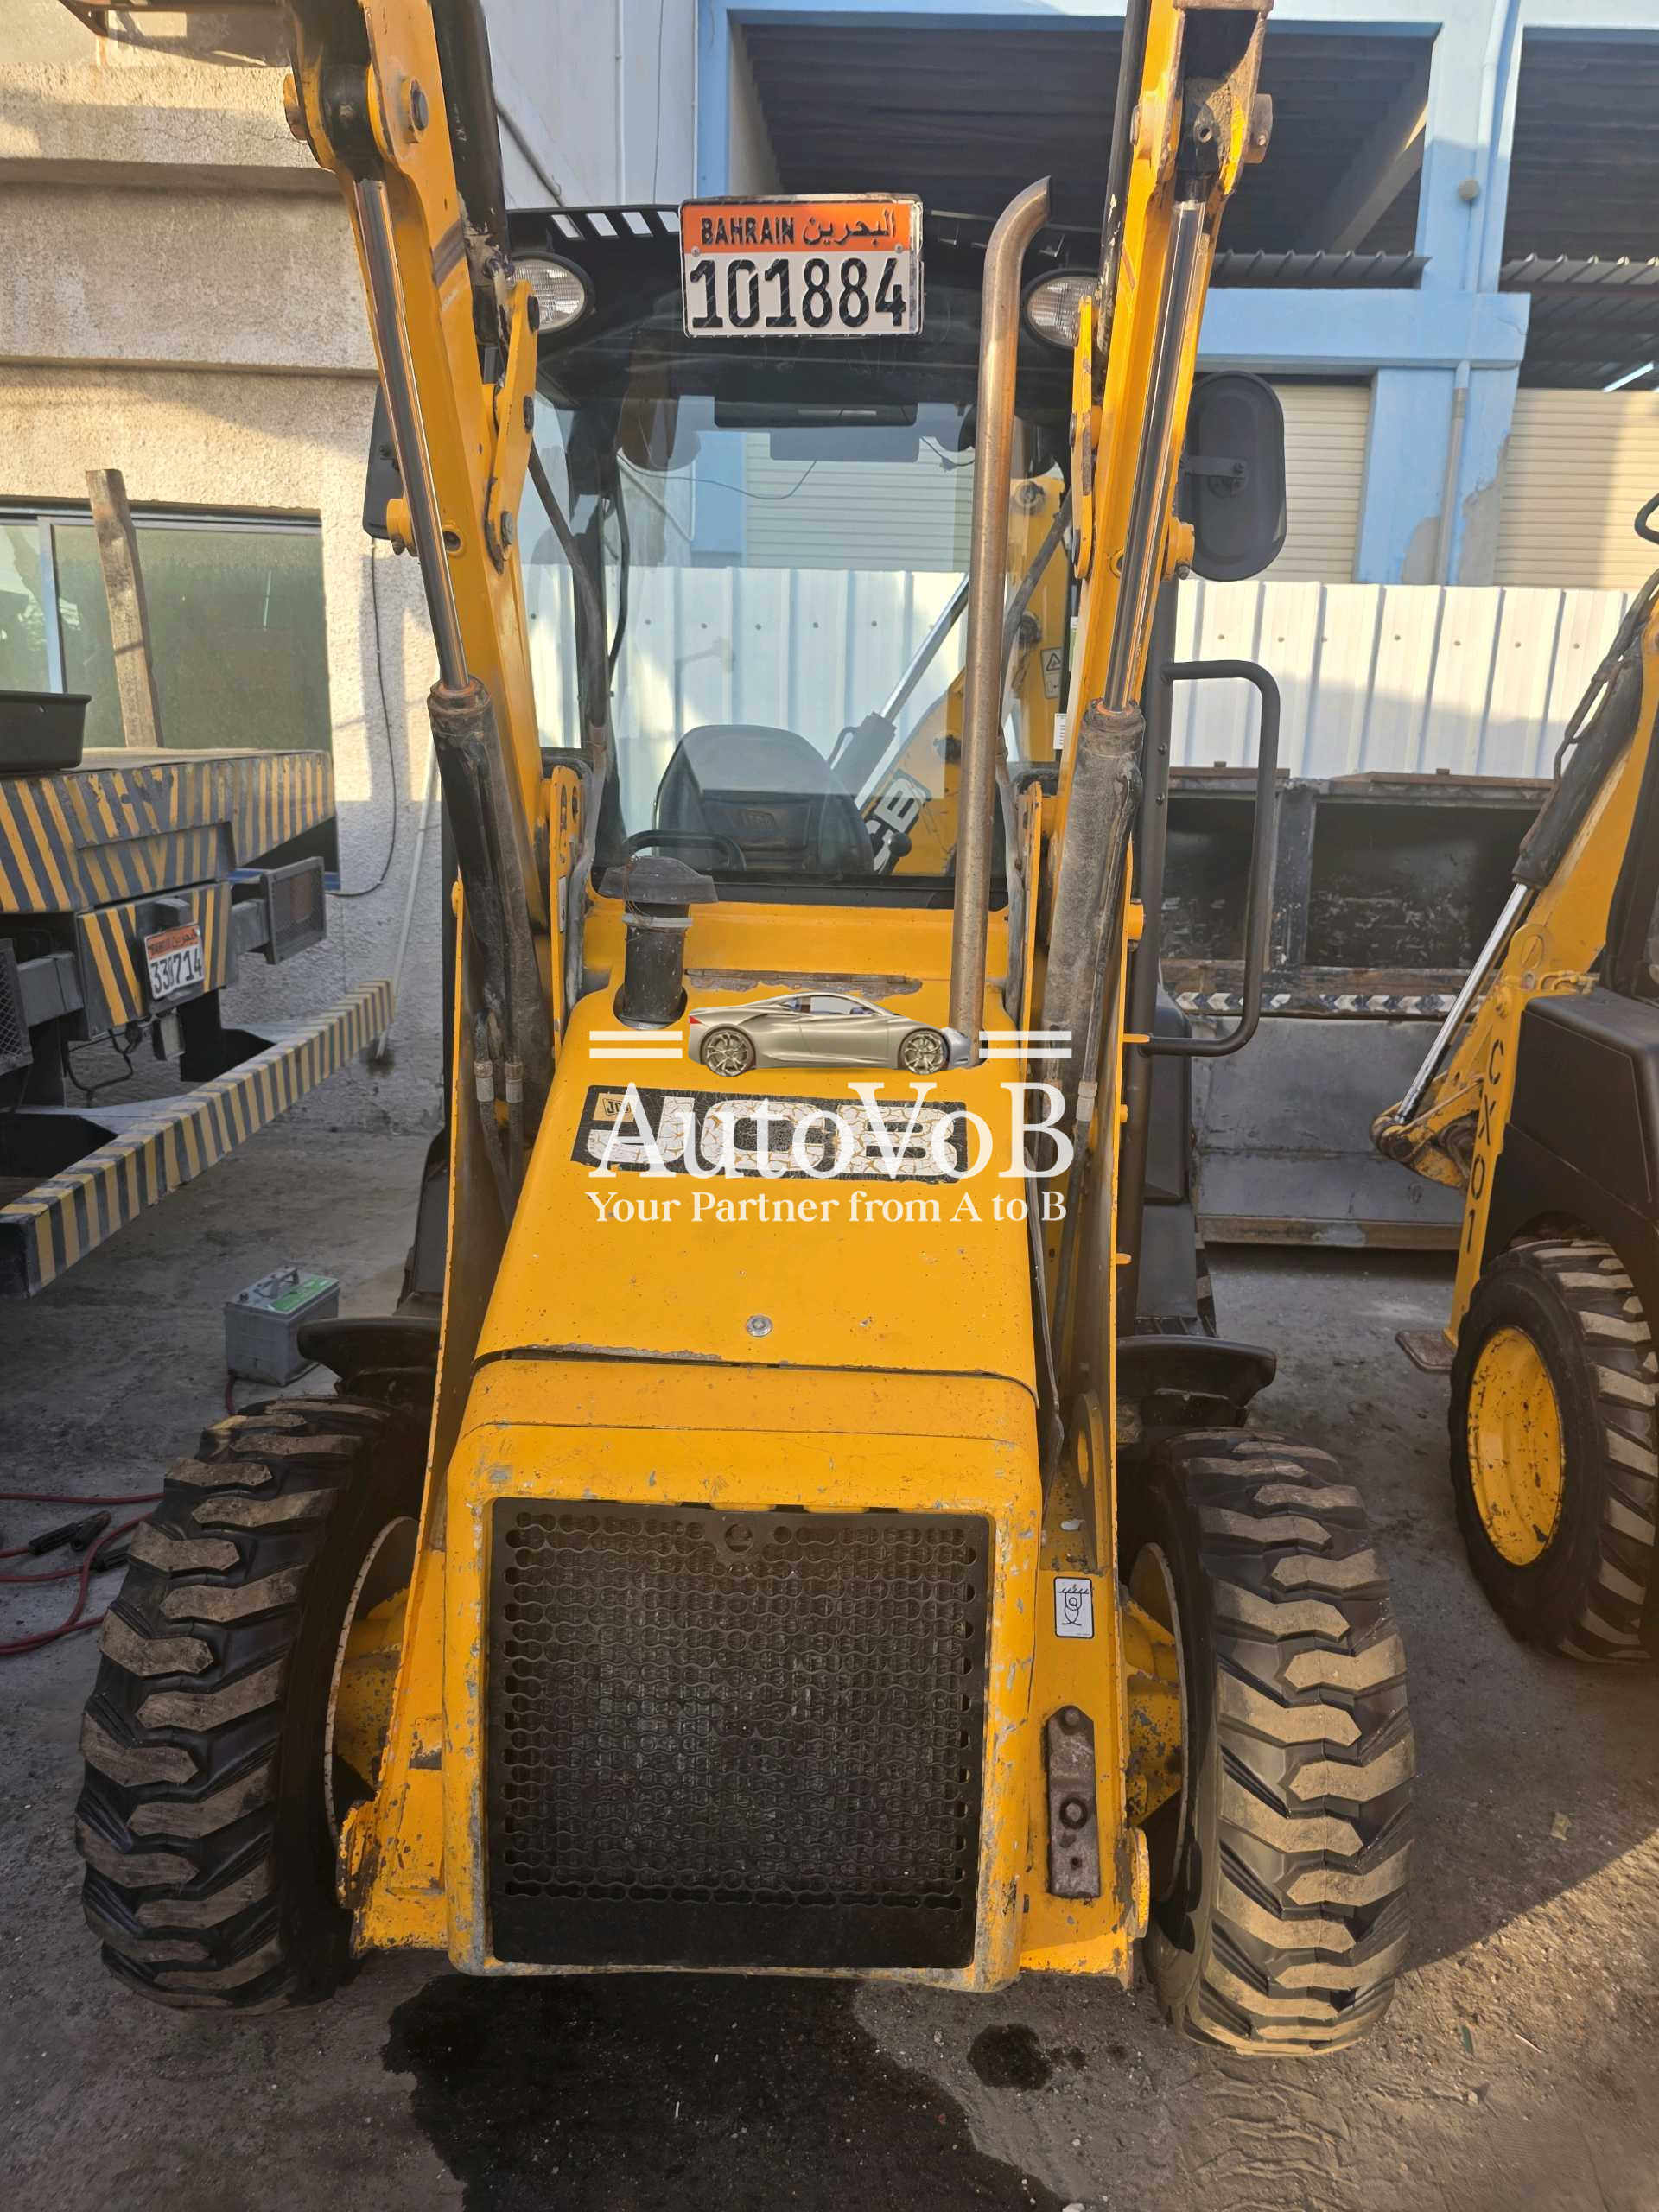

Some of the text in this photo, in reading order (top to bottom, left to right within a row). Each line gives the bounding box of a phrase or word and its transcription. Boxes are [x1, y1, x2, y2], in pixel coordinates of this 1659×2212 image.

[701, 216, 795, 245] BAHRAIN
[802, 207, 898, 247] البحرين
[690, 257, 906, 328] 101884
